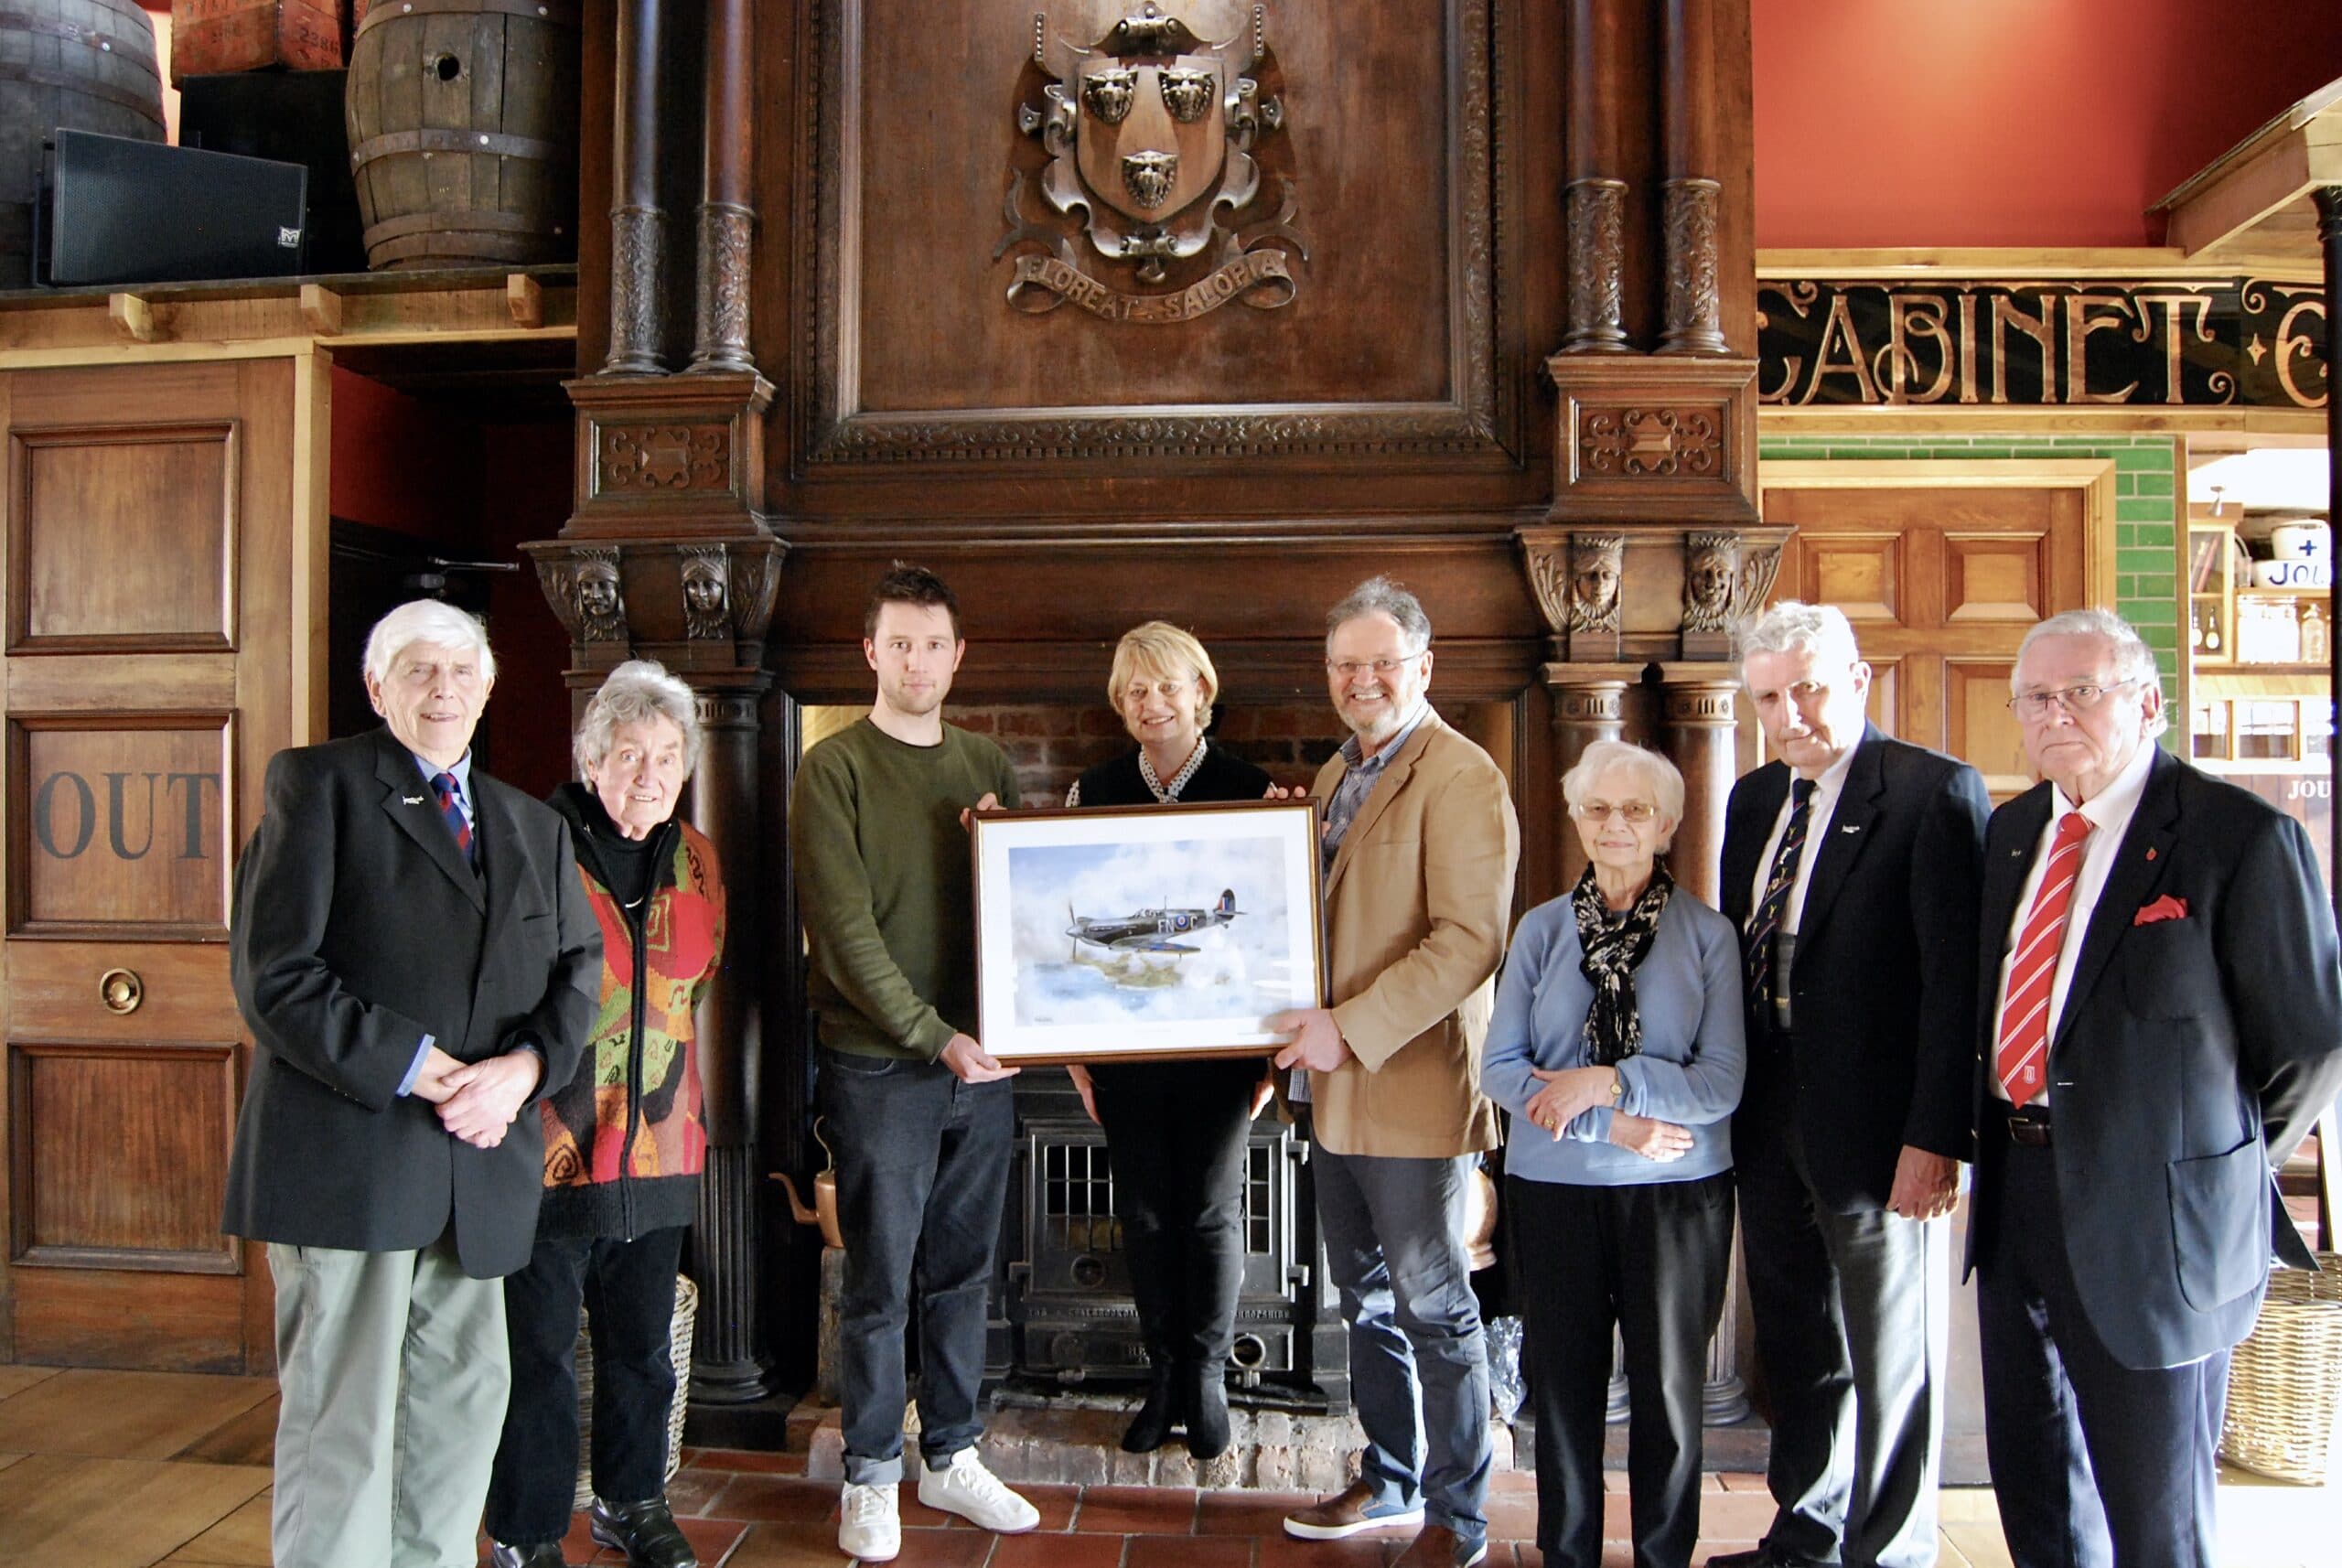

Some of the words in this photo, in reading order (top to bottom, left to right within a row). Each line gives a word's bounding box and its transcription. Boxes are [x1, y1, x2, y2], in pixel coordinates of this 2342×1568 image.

[1027, 258, 1138, 320] FLOREAT
[1164, 256, 1278, 318] SALOPIA
[34, 771, 220, 861] OUT
